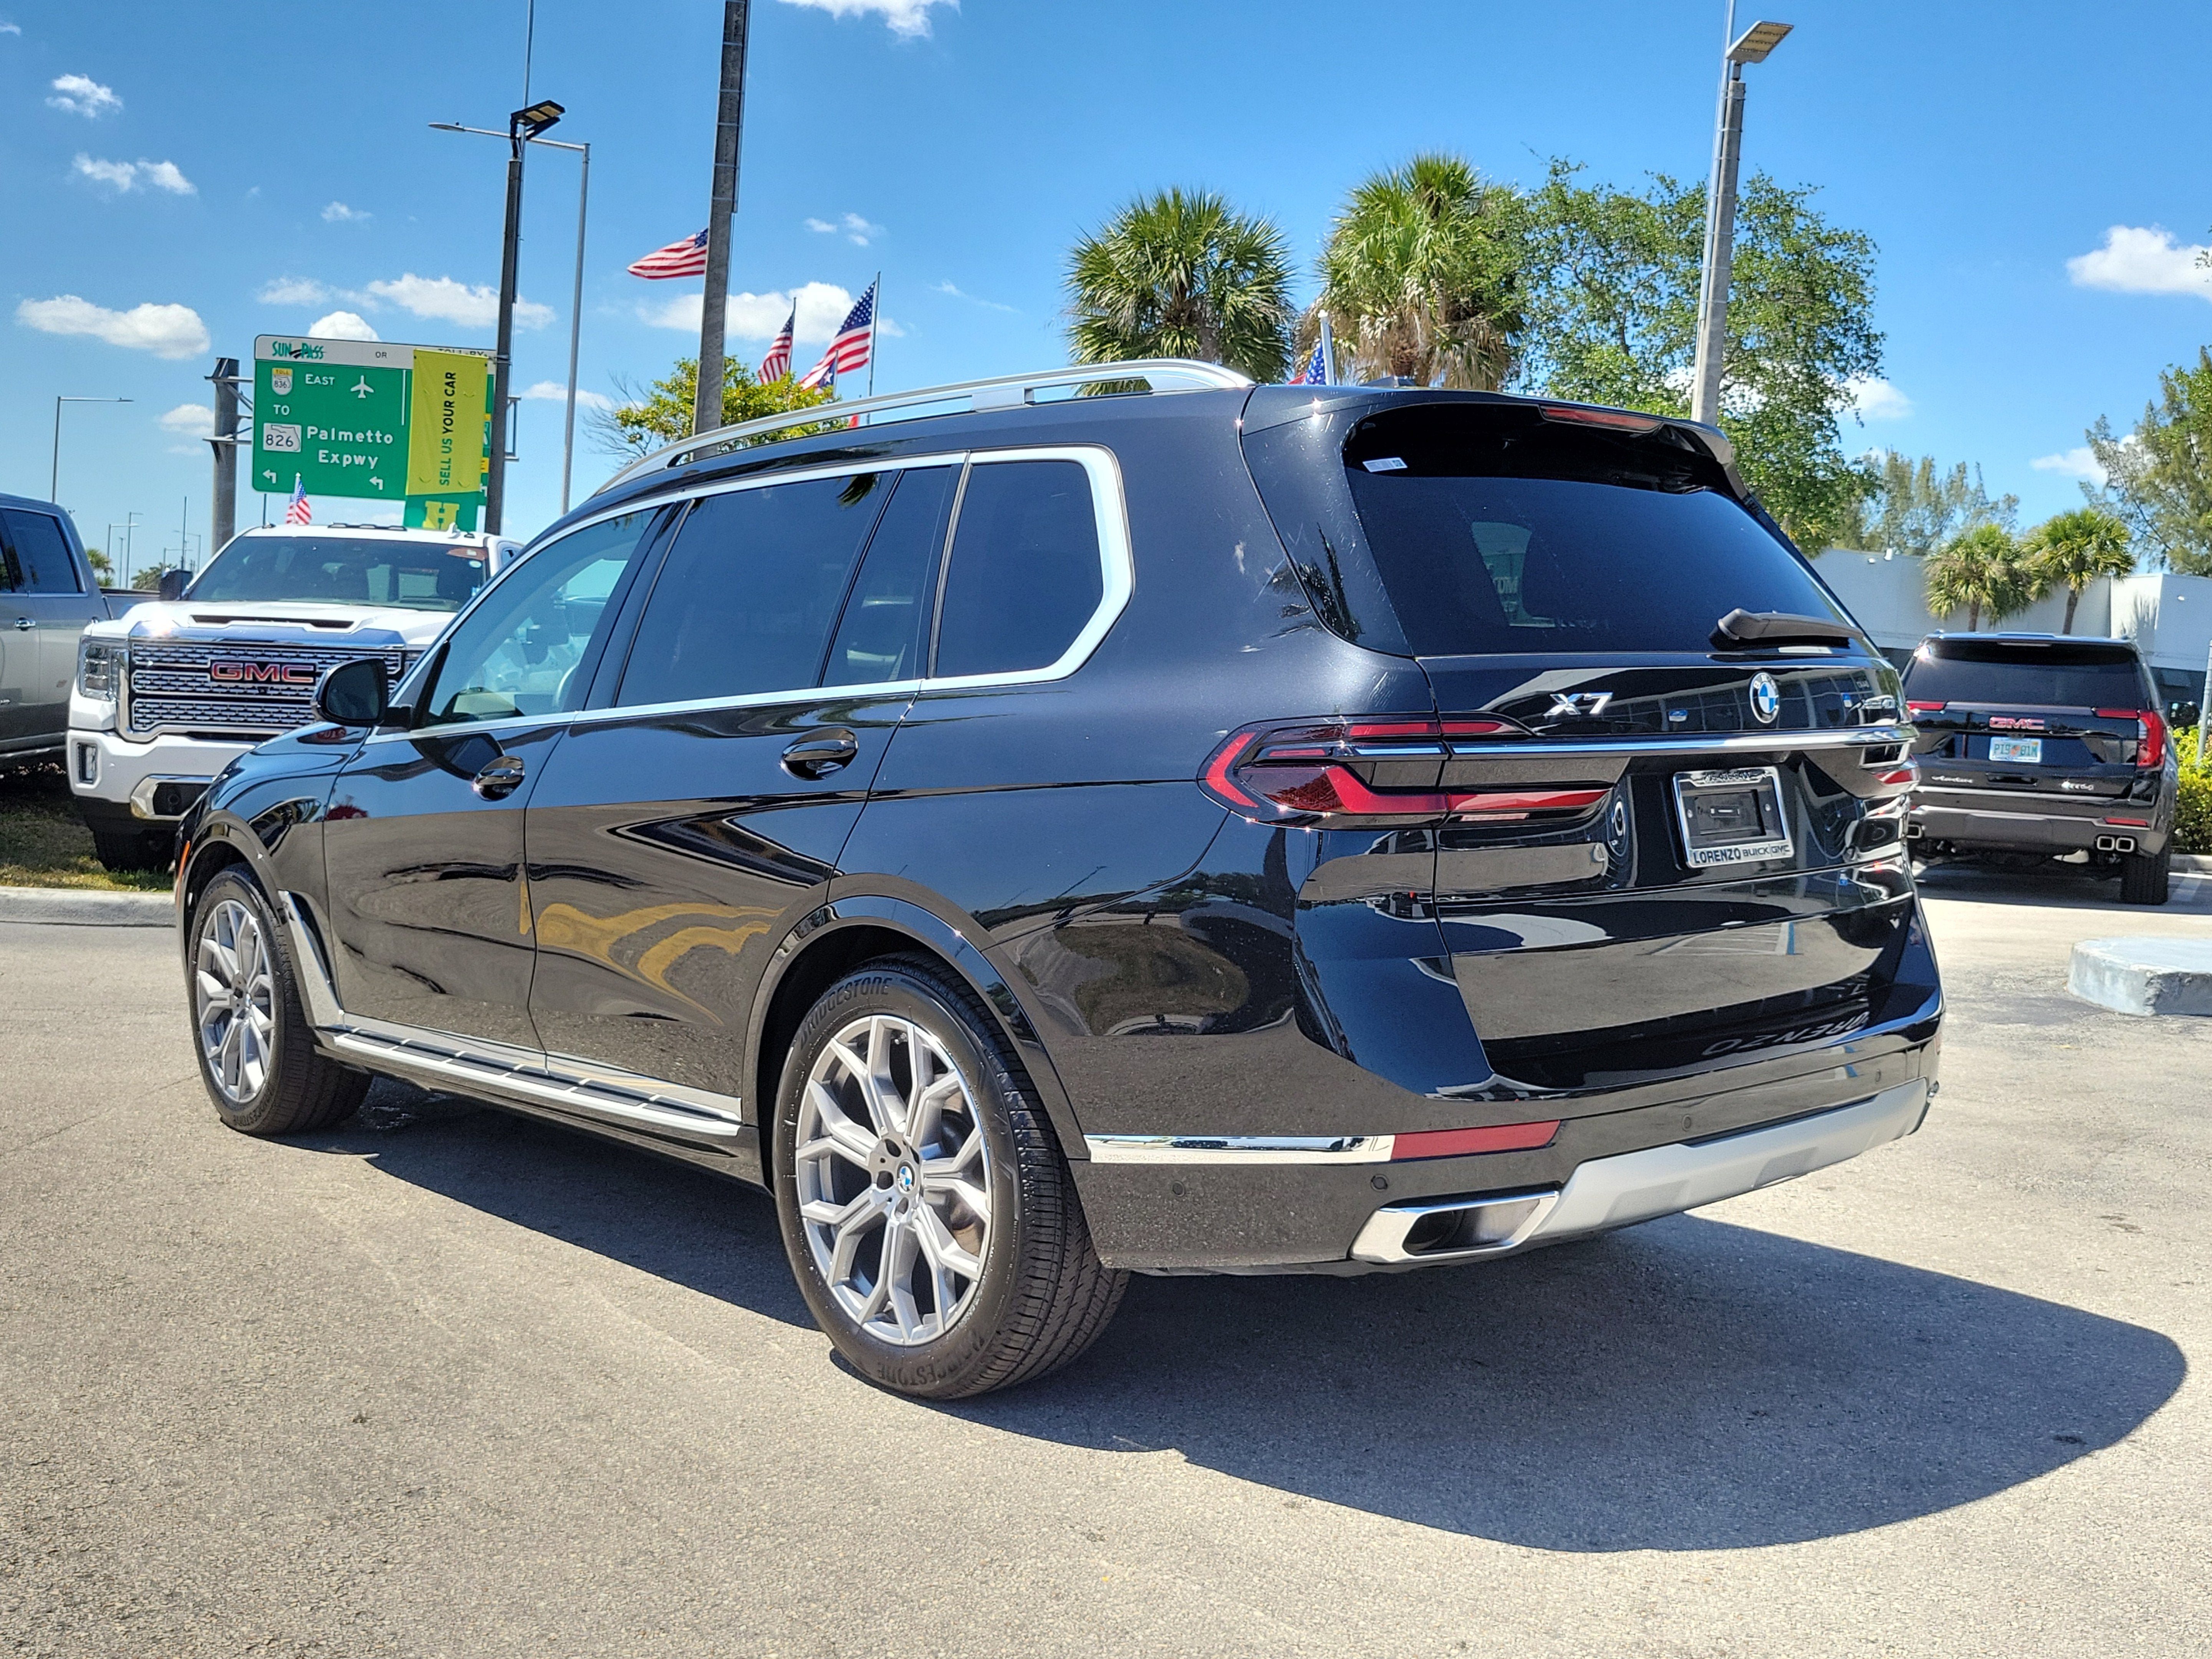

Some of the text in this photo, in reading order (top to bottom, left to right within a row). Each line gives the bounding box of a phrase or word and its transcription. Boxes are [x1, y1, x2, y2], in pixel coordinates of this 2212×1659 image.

[273, 404, 290, 415] TO
[307, 426, 393, 444] Palmetto
[439, 371, 457, 486] SELL US YOUR CAR
[265, 434, 294, 447] 826
[318, 450, 378, 469] Expwy
[212, 662, 314, 683] GMC
[1543, 692, 1613, 716] X7
[1989, 717, 2045, 730] GMC
[1693, 848, 1741, 864] LORENZO
[1743, 847, 1770, 857] BUICK
